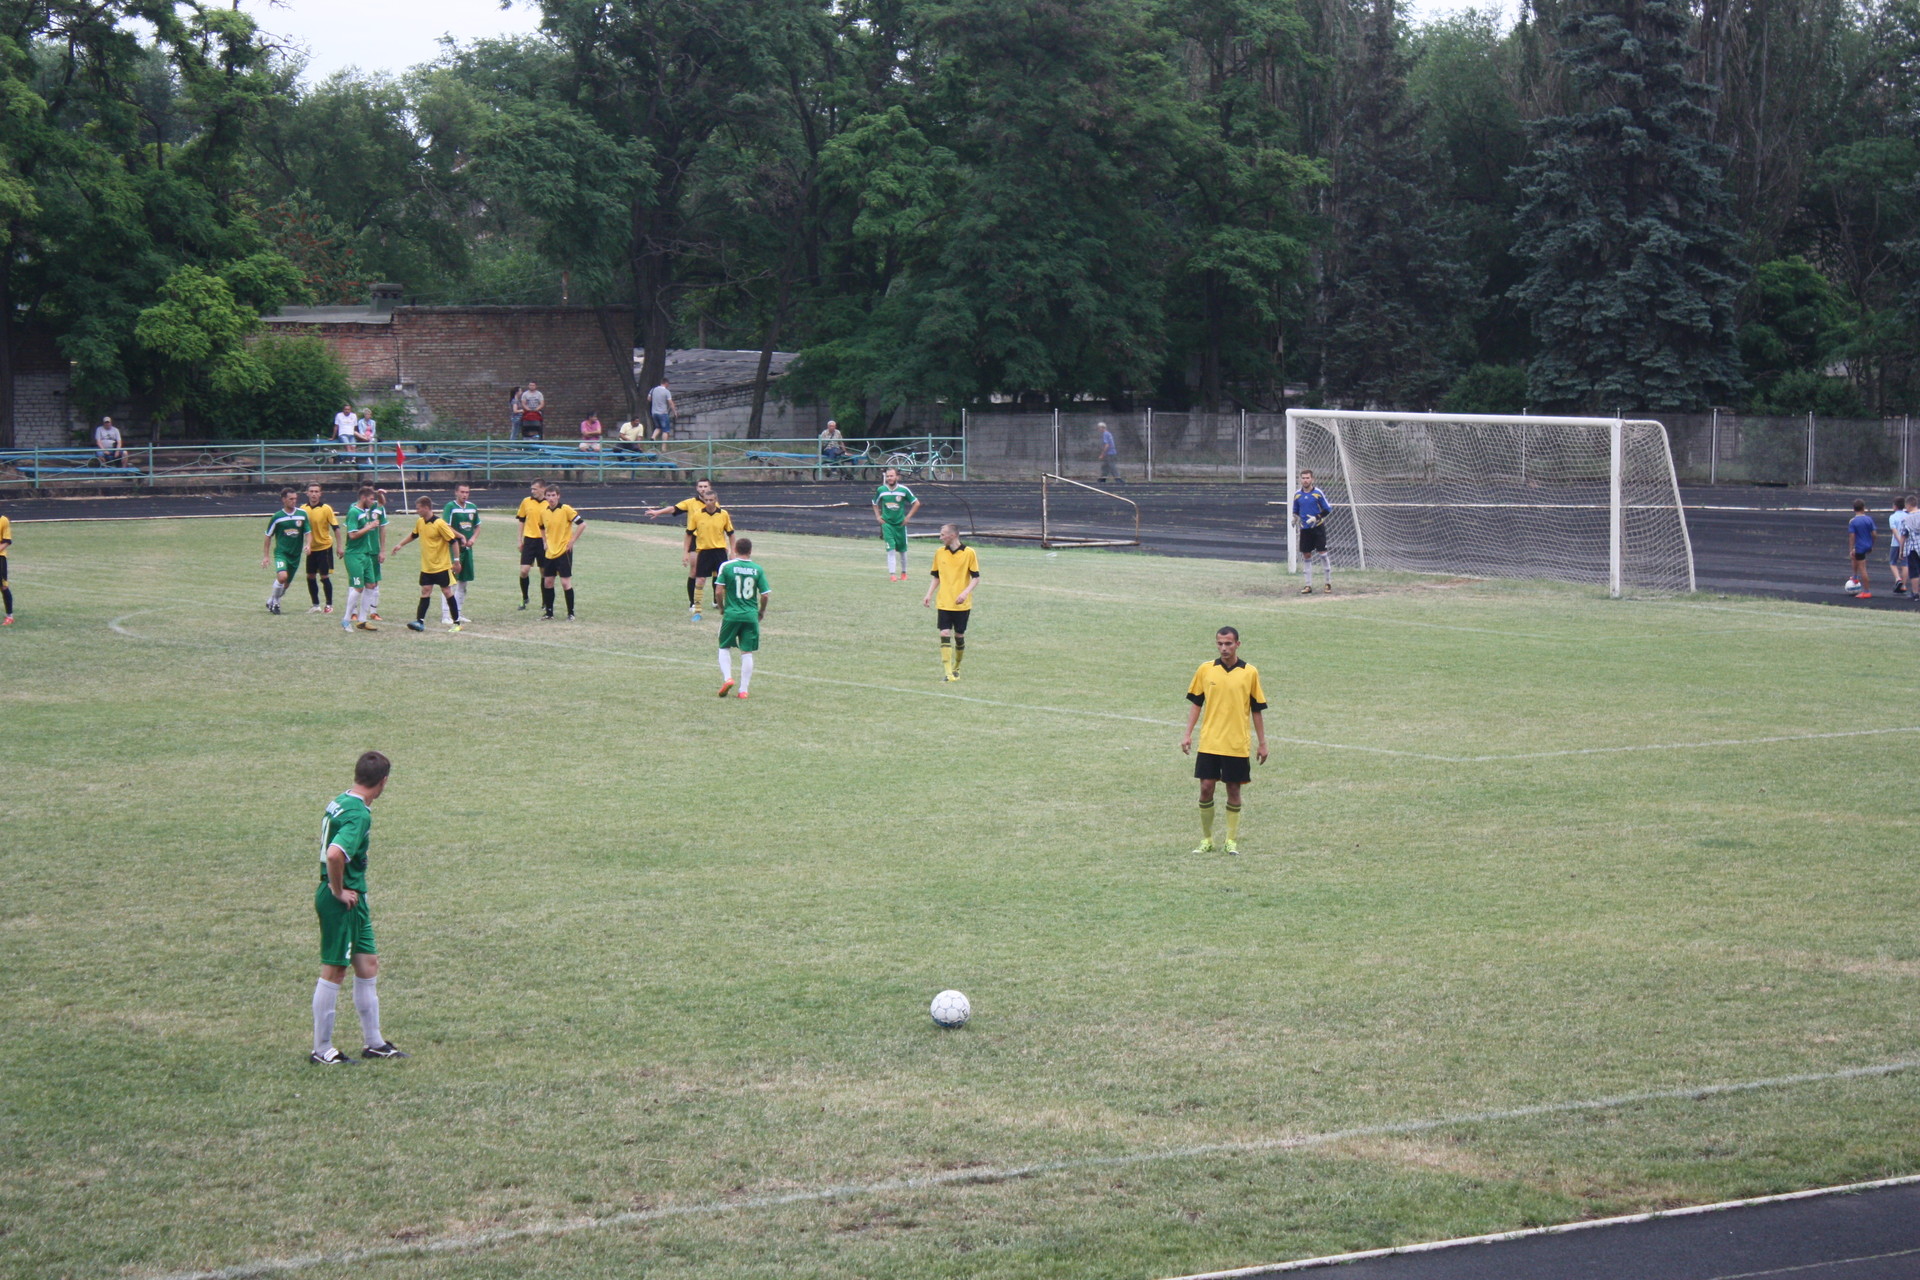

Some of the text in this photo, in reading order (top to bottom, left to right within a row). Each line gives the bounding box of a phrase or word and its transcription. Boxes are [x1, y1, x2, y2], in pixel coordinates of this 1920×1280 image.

[277, 561, 284, 569] 19
[353, 577, 361, 586] 16
[735, 575, 755, 600] 18
